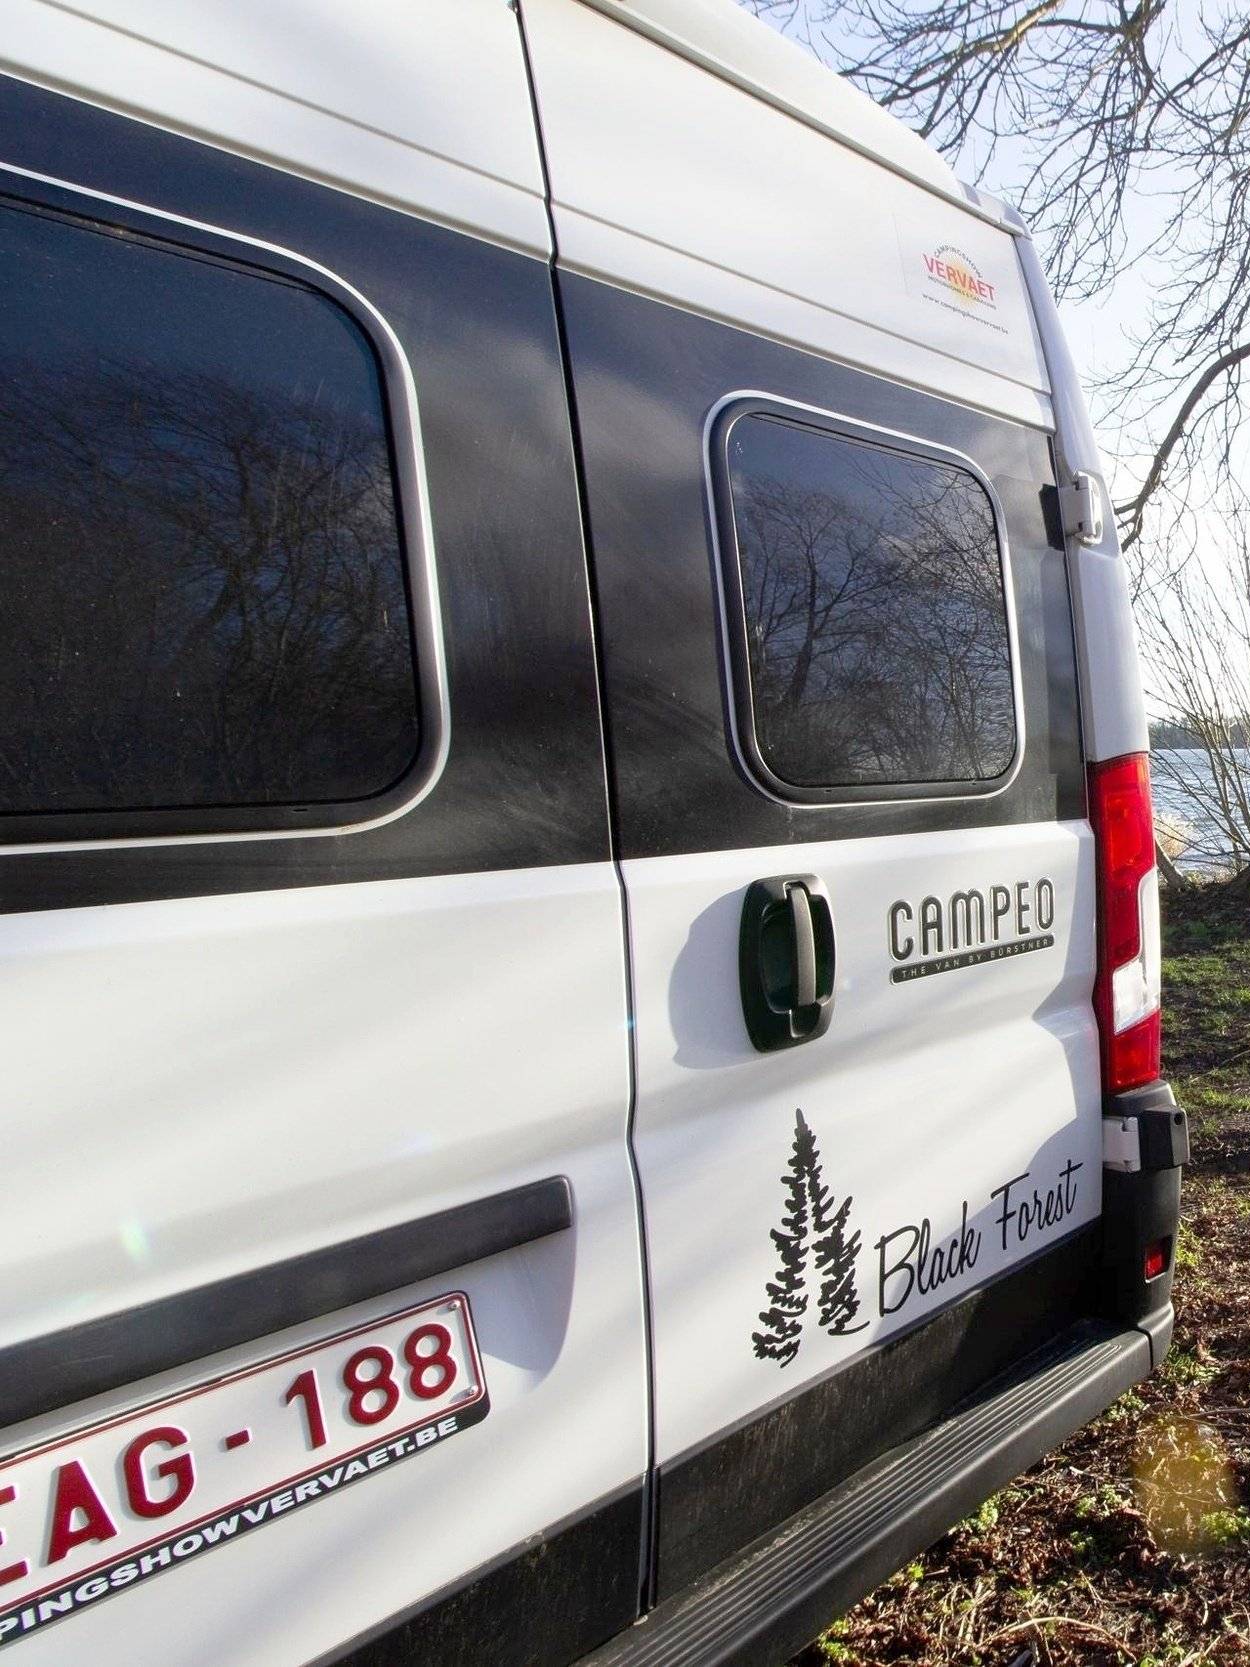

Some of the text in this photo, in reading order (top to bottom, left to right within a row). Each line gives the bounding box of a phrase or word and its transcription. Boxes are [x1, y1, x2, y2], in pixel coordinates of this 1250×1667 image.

[923, 254, 995, 301] VERVAET
[889, 877, 1055, 961] CAMPEO
[901, 967, 926, 979] THE
[935, 959, 961, 971] VAN
[968, 953, 982, 963] BY
[874, 1159, 1083, 1317] Black Forest
